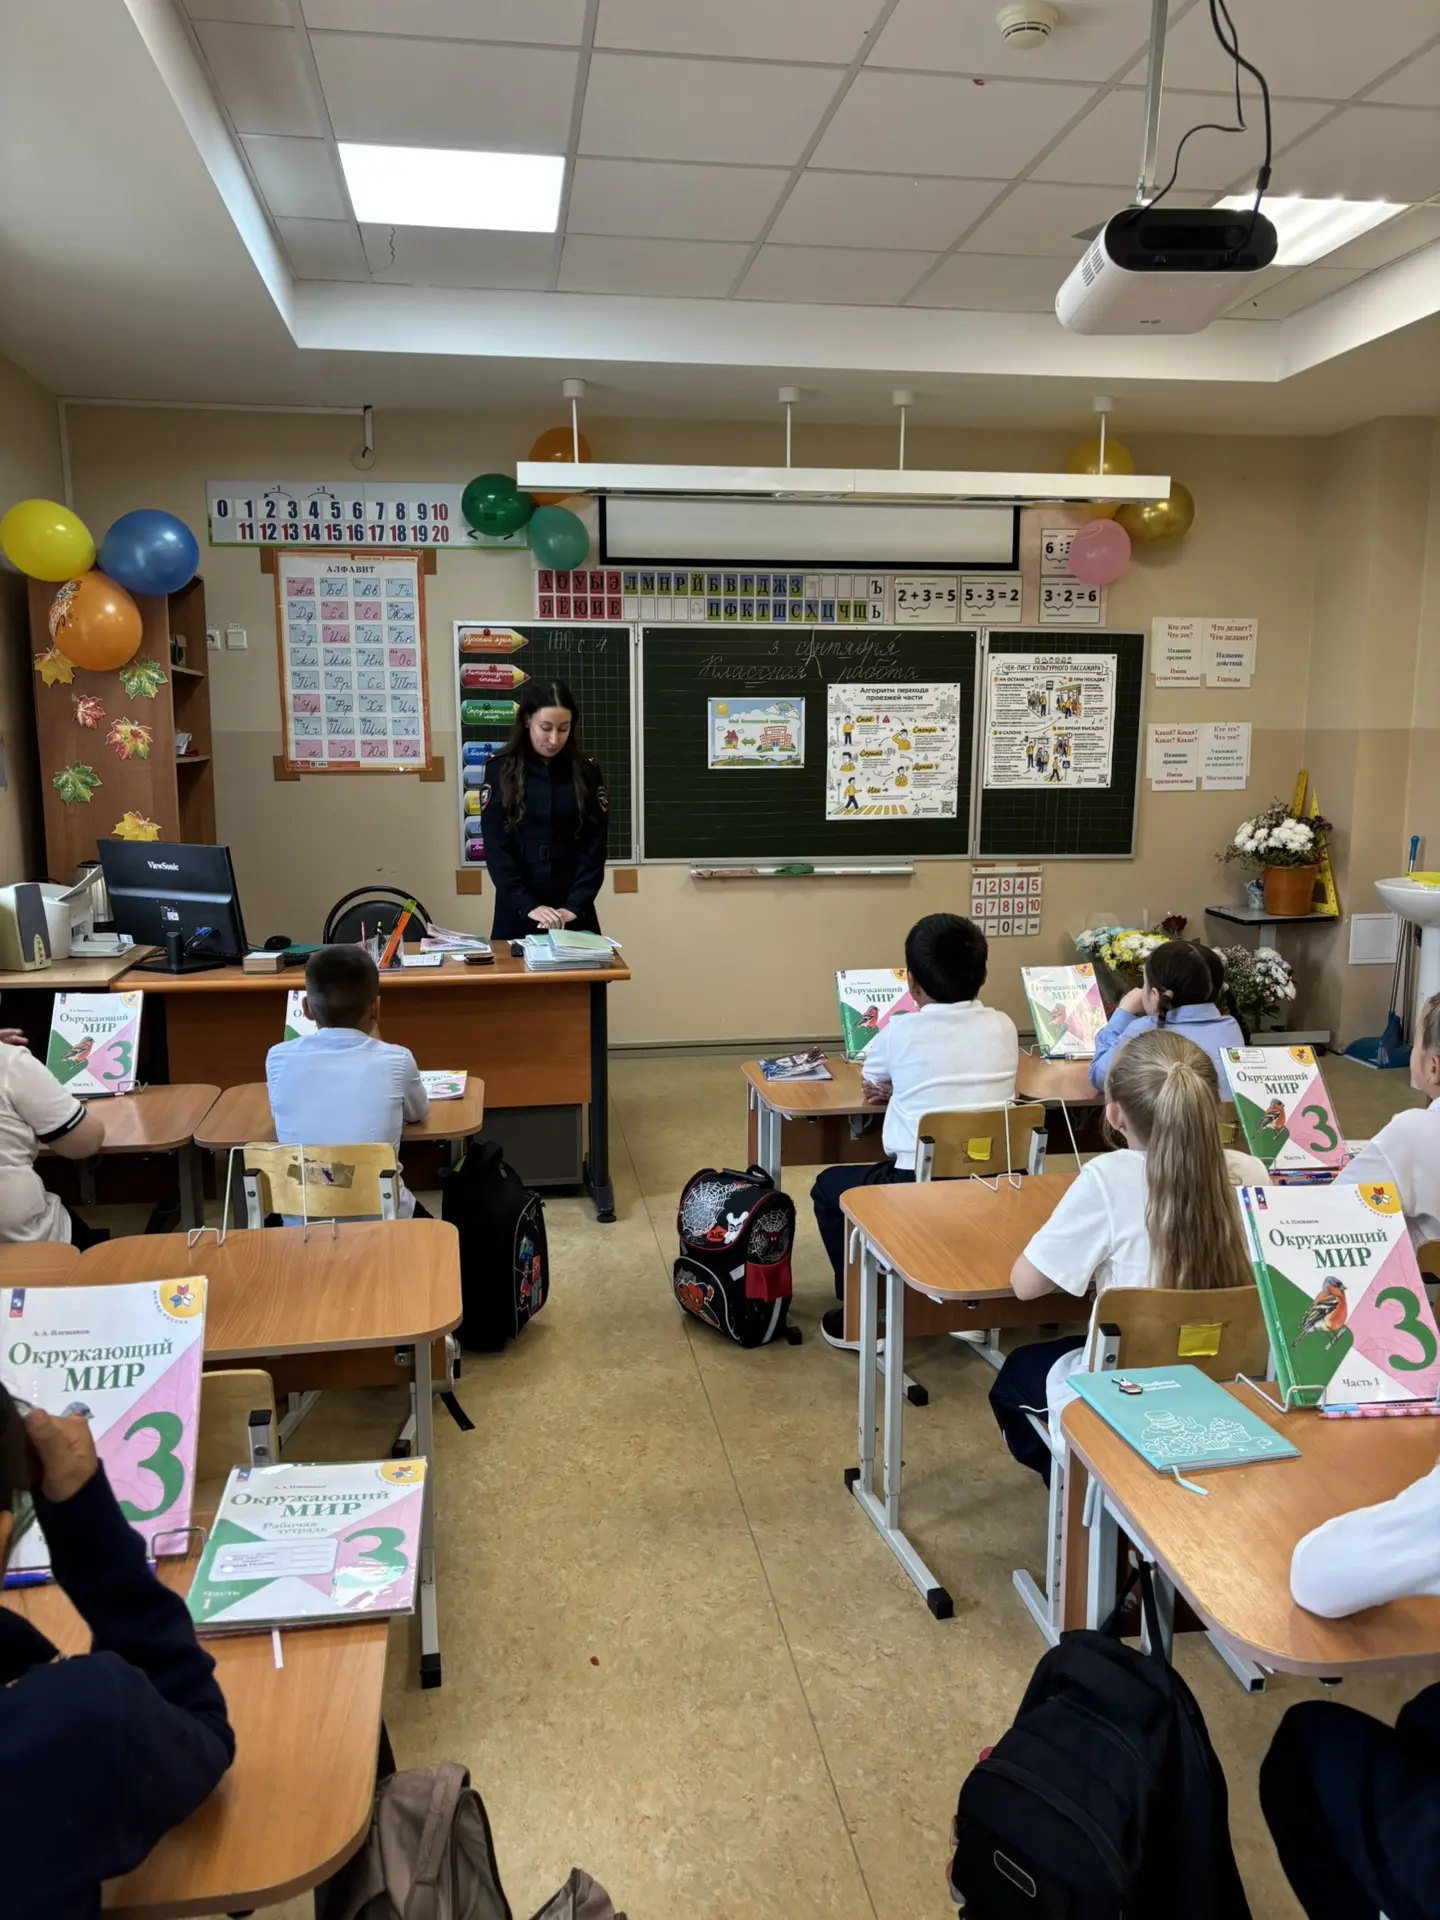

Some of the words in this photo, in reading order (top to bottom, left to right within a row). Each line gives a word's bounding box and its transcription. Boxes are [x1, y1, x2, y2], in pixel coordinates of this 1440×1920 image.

[217, 500, 228, 517] 0
[245, 500, 252, 518] 1
[266, 501, 275, 518] 2
[288, 501, 297, 518] 3
[309, 501, 319, 518] 4
[331, 502, 340, 518] 5
[353, 503, 362, 519] 6
[376, 503, 384, 519] 7
[396, 503, 405, 519] 8
[418, 503, 427, 520] 9
[431, 504, 448, 520] 10
[239, 523, 253, 539] 11
[260, 523, 276, 539] 12
[281, 523, 299, 540] 13
[303, 524, 320, 540] 14
[325, 524, 342, 540] 15
[347, 524, 363, 541] 16
[369, 525, 384, 541] 17
[390, 525, 406, 541] 18
[411, 525, 428, 541] 19
[432, 526, 449, 542] 20
[541, 573, 549, 588] А
[558, 574, 567, 589] О
[575, 574, 585, 589] У
[590, 574, 604, 589] Ы
[609, 575, 619, 590] Э
[626, 576, 636, 590] Л
[642, 577, 654, 590] М
[659, 577, 669, 591] Н
[676, 577, 685, 591] Р
[692, 573, 704, 591] Й
[709, 578, 718, 591] Б
[726, 578, 735, 591] В
[744, 578, 752, 591] Г
[758, 578, 768, 594] Д
[773, 579, 786, 593] Ж
[791, 579, 800, 593] З
[871, 580, 882, 594] Ъ
[542, 600, 551, 614] Я
[560, 597, 568, 614] Ё
[574, 601, 587, 615] Ю
[592, 602, 604, 614] И
[610, 601, 620, 615] Е
[709, 603, 720, 616] П
[724, 603, 737, 616] Ф
[742, 603, 752, 617] К
[759, 603, 769, 617] Т
[773, 604, 786, 617] Ш
[791, 604, 800, 618] С
[806, 604, 817, 618] Х
[823, 605, 834, 621] Ц
[840, 605, 849, 618] Ч
[854, 605, 866, 620] Щ
[872, 606, 880, 618] Ь
[700, 655, 808, 680] Классная
[837, 659, 920, 684] работа
[147, 861, 179, 871] ViewSonic
[976, 881, 981, 892] 1
[989, 881, 996, 892] 2
[1003, 880, 1010, 891] 3
[1017, 880, 1024, 891] 4
[1032, 880, 1038, 890] 5
[975, 903, 982, 914] 6
[989, 901, 995, 912] 7
[1003, 901, 1009, 912] 8
[1017, 901, 1023, 912] 9
[1029, 900, 1039, 911] 10
[845, 986, 902, 995] Окружающий
[866, 994, 894, 1002] МИР
[60, 1013, 128, 1024] Окружающий
[82, 1023, 116, 1033] МИР
[103, 1041, 132, 1079] 3
[1237, 1071, 1308, 1083] Окружающий
[1265, 1083, 1299, 1094] МИР
[1301, 1105, 1338, 1152] 3
[1269, 1229, 1388, 1249] Окружающий
[1312, 1248, 1371, 1269] МИР
[1375, 1287, 1437, 1371] 3
[9, 1338, 173, 1369] Окружающий
[63, 1363, 145, 1392] МИР
[1343, 1379, 1372, 1388] Часть
[1374, 1378, 1380, 1386] 1
[120, 1411, 184, 1522] 3
[231, 1490, 389, 1506] Окружающий
[281, 1502, 361, 1517] МИР
[263, 1522, 317, 1530] Рабочая
[332, 1527, 407, 1588] 3
